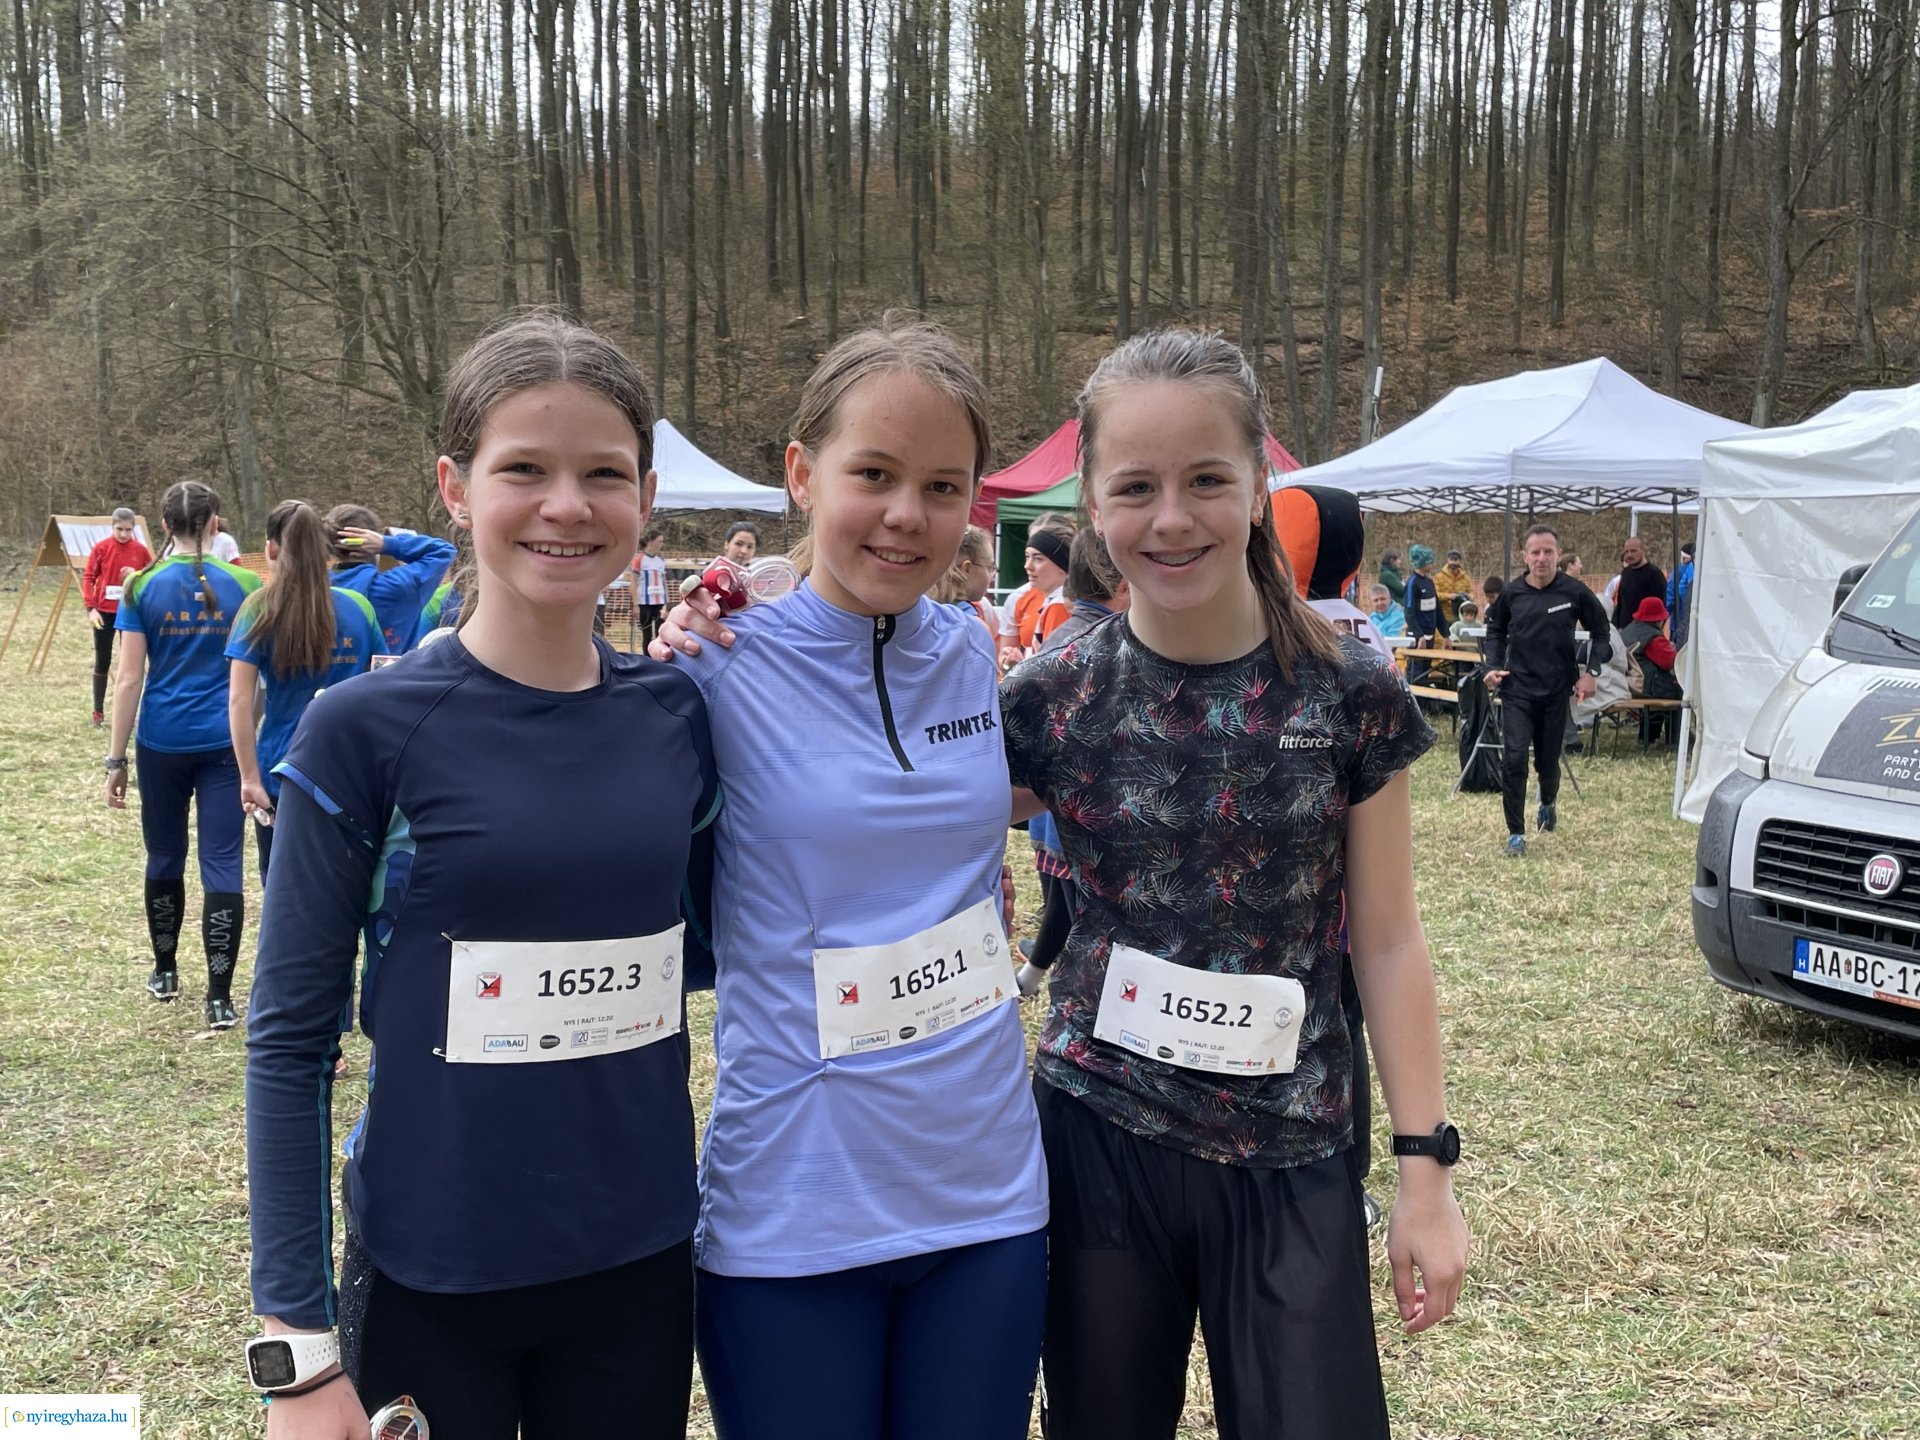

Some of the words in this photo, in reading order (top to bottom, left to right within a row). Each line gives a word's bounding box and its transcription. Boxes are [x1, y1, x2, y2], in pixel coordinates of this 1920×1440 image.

[1279, 734, 1333, 749] fitforce
[1882, 716, 1920, 742] Z
[1883, 754, 1920, 769] PART
[1883, 766, 1911, 779] AND
[1870, 865, 1894, 886] FIAT
[209, 908, 233, 951] JUVA
[889, 949, 968, 1000] 1652.1
[1798, 958, 1806, 970] H
[1813, 948, 1841, 979] AA
[537, 963, 642, 998] 1652.3
[1160, 992, 1253, 1028] 1652.2
